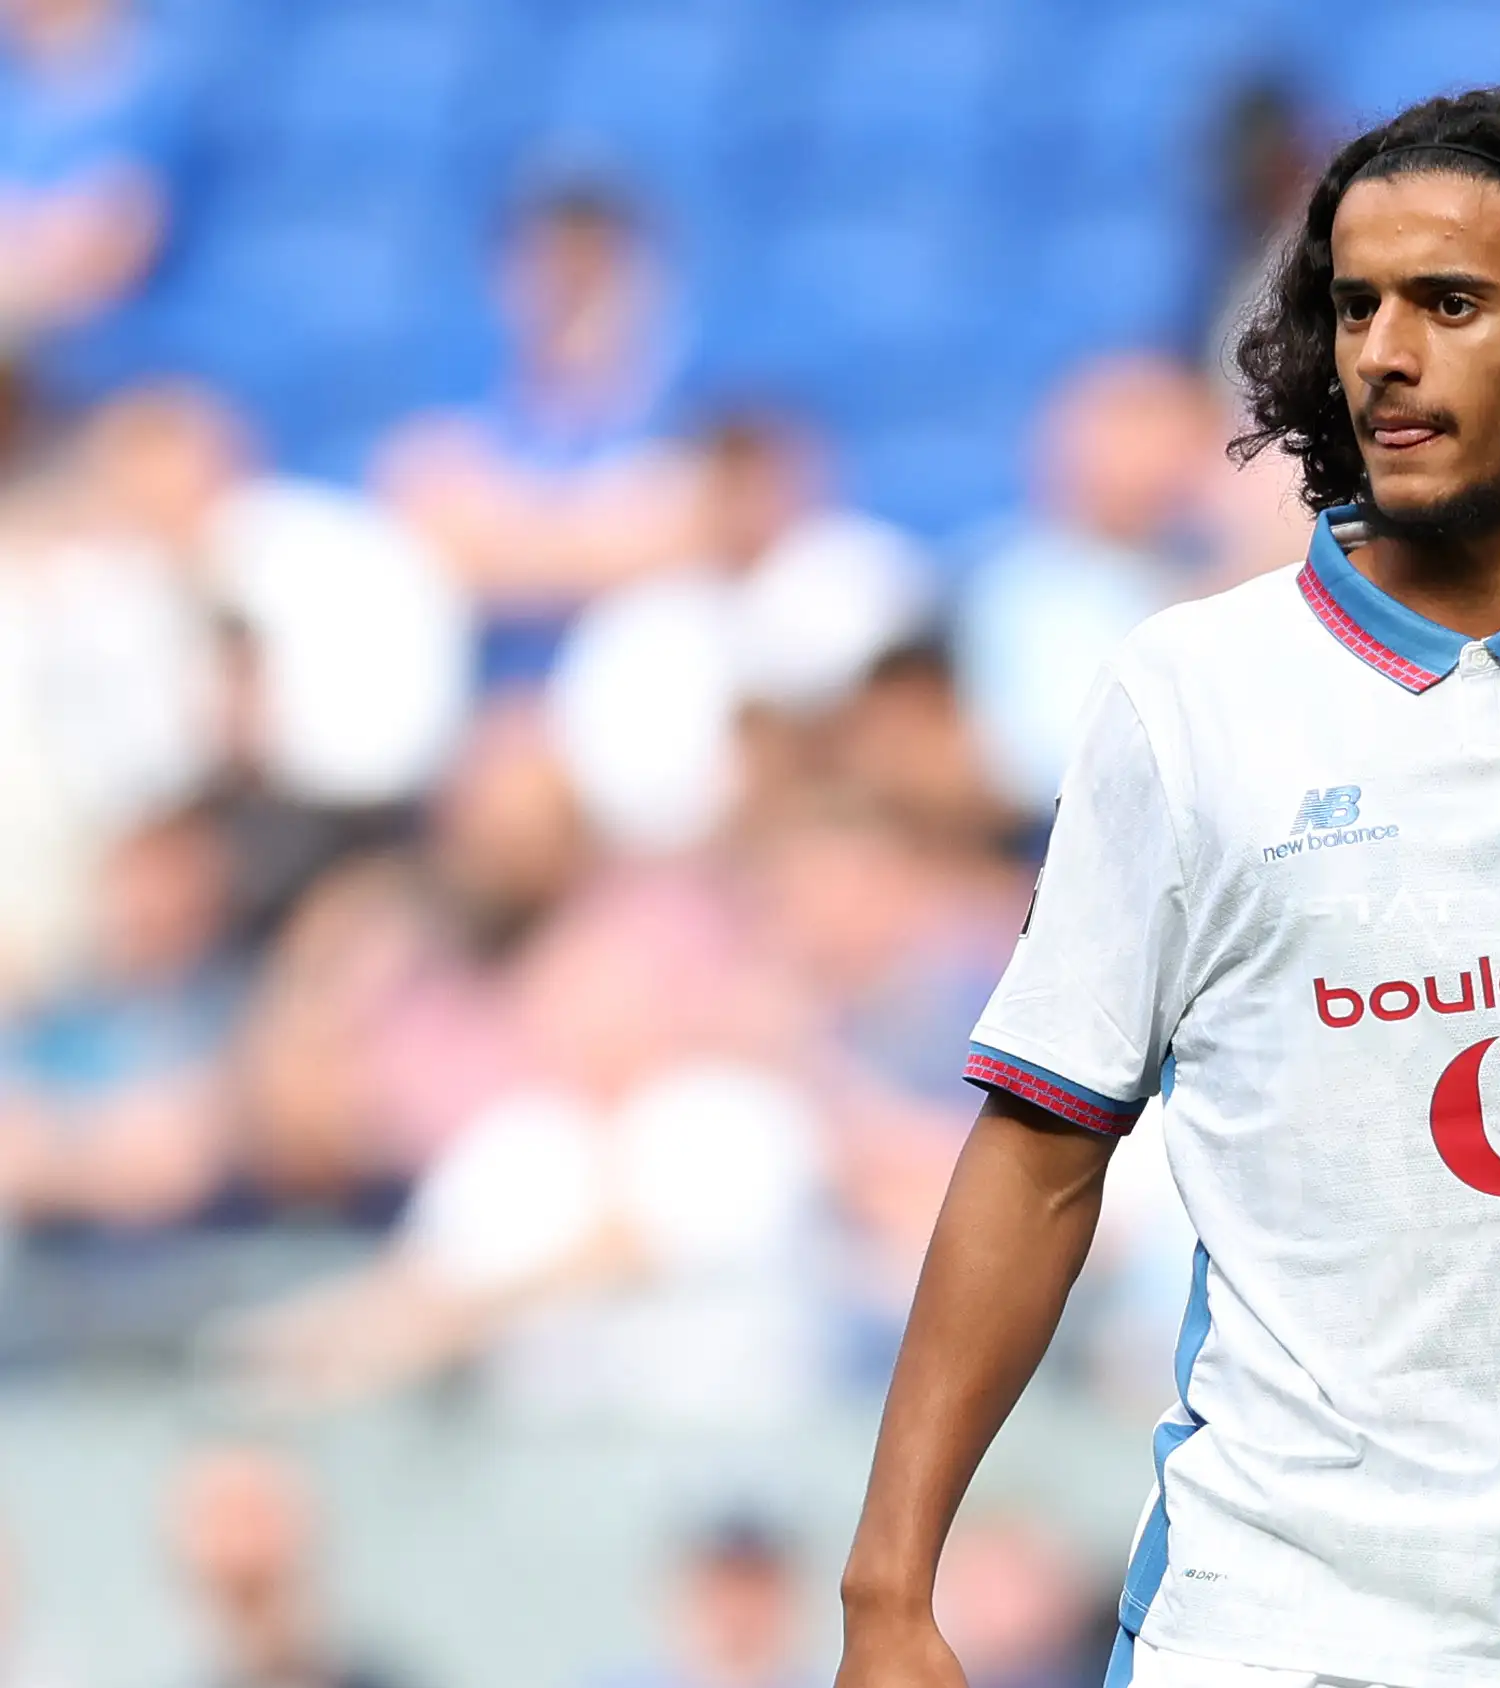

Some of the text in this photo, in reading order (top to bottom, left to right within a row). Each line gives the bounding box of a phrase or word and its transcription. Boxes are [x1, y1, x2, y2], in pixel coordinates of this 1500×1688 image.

[1289, 784, 1362, 836] NB
[1262, 824, 1399, 863] new balance
